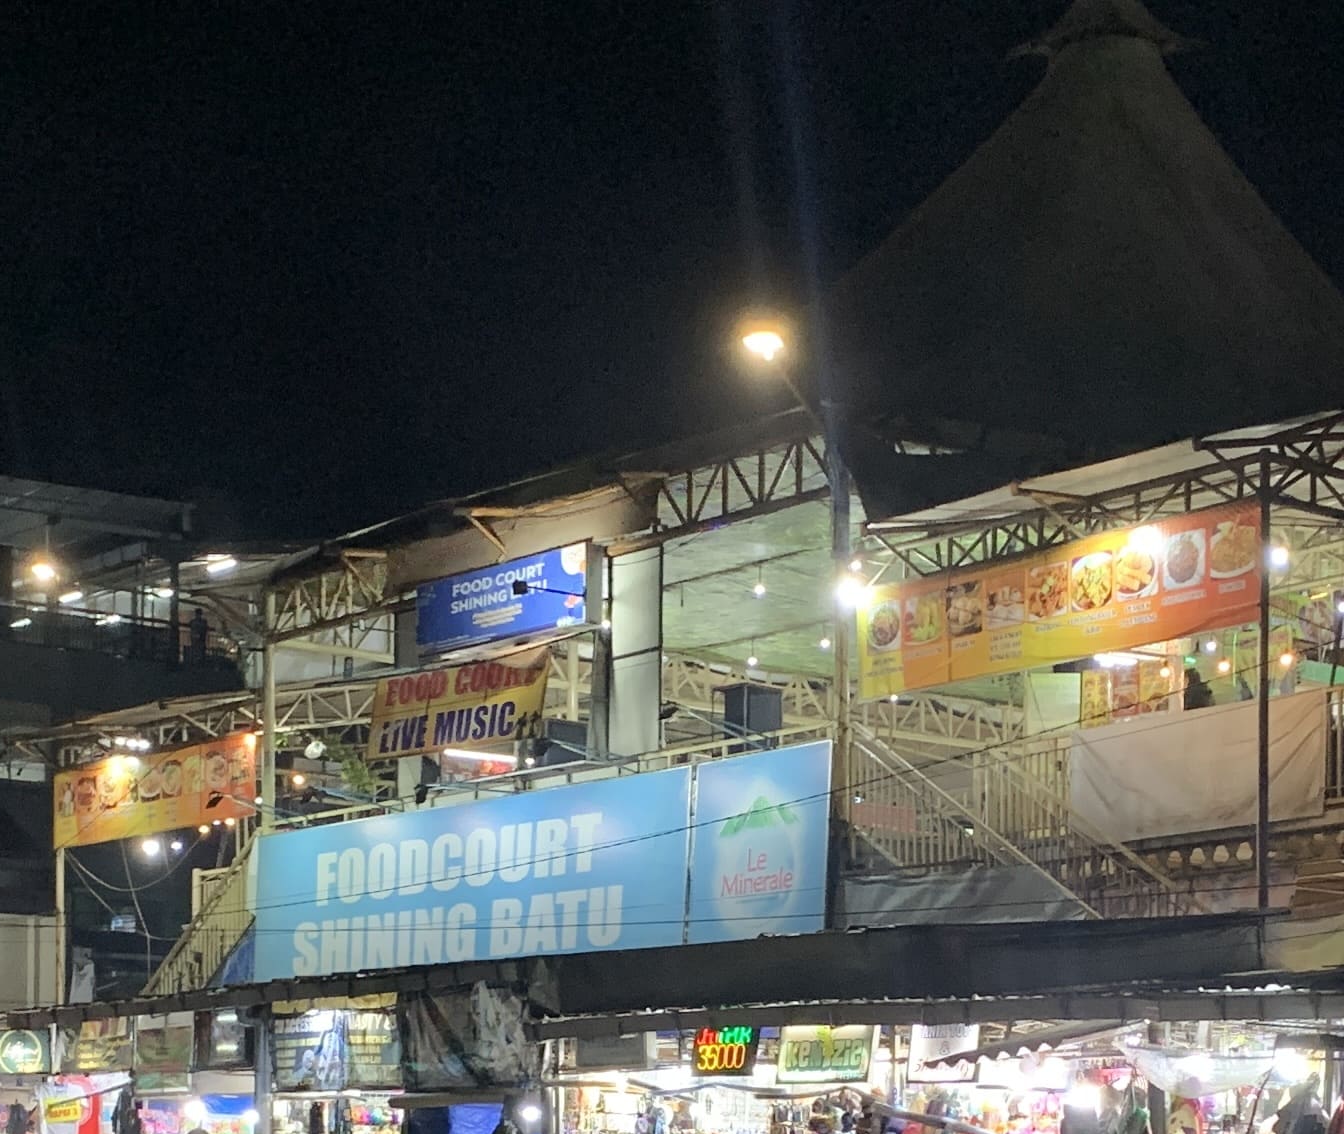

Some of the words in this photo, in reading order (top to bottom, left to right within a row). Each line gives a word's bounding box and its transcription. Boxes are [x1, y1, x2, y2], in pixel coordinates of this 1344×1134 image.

[452, 576, 493, 598] FOOD
[496, 562, 545, 585] COURT
[450, 592, 507, 615] SHINING
[385, 671, 449, 707] FOOD
[378, 714, 429, 755] LIVE
[433, 701, 516, 746] MUSIC
[316, 812, 603, 907] FOODCOURT
[747, 848, 768, 871] Le
[720, 867, 794, 898] Minerale
[292, 902, 477, 977] SHINING
[490, 885, 624, 956] BATU
[697, 1044, 746, 1070] 35000
